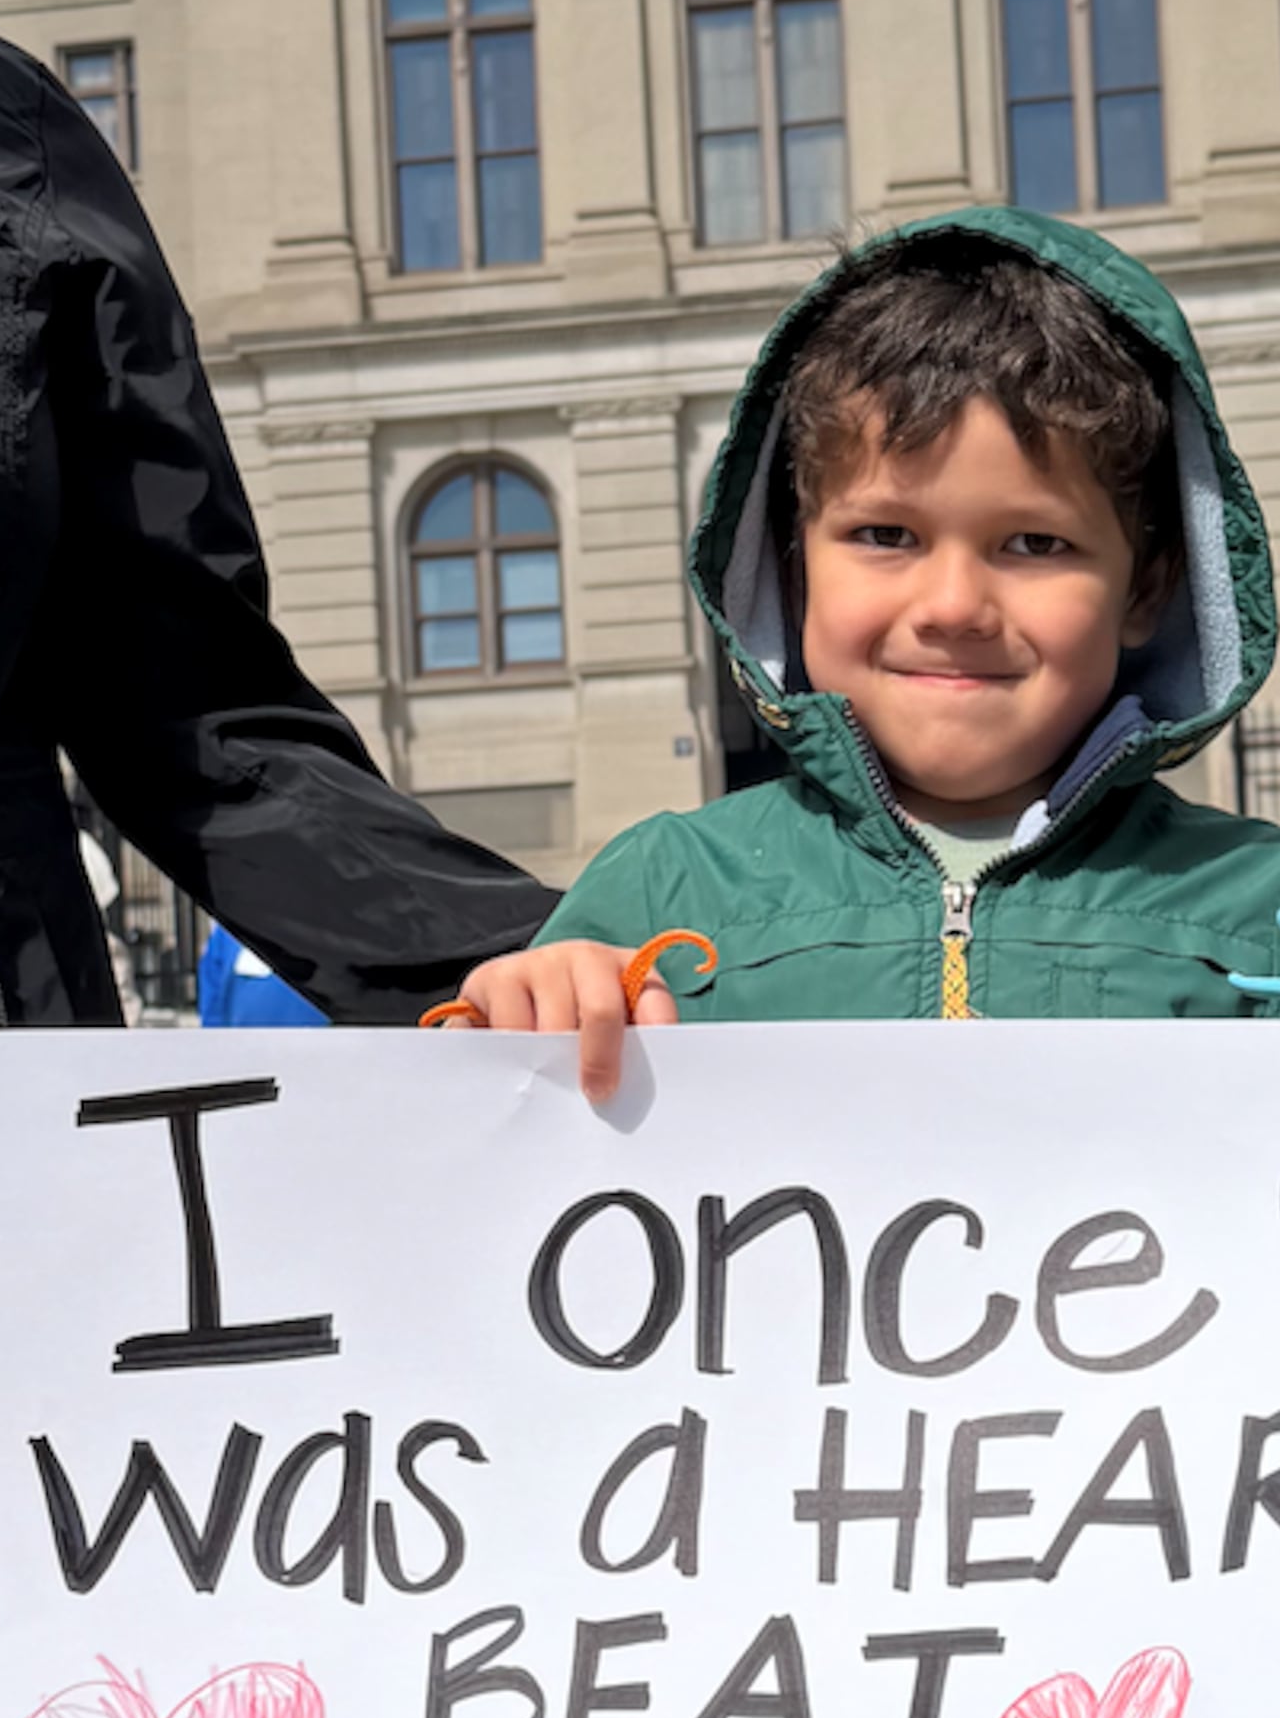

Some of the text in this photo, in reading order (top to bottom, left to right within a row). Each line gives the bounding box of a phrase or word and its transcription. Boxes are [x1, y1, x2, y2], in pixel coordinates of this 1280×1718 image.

[76, 1077, 1219, 1384] I once
[28, 1411, 489, 1604] was
[581, 1408, 706, 1576] a
